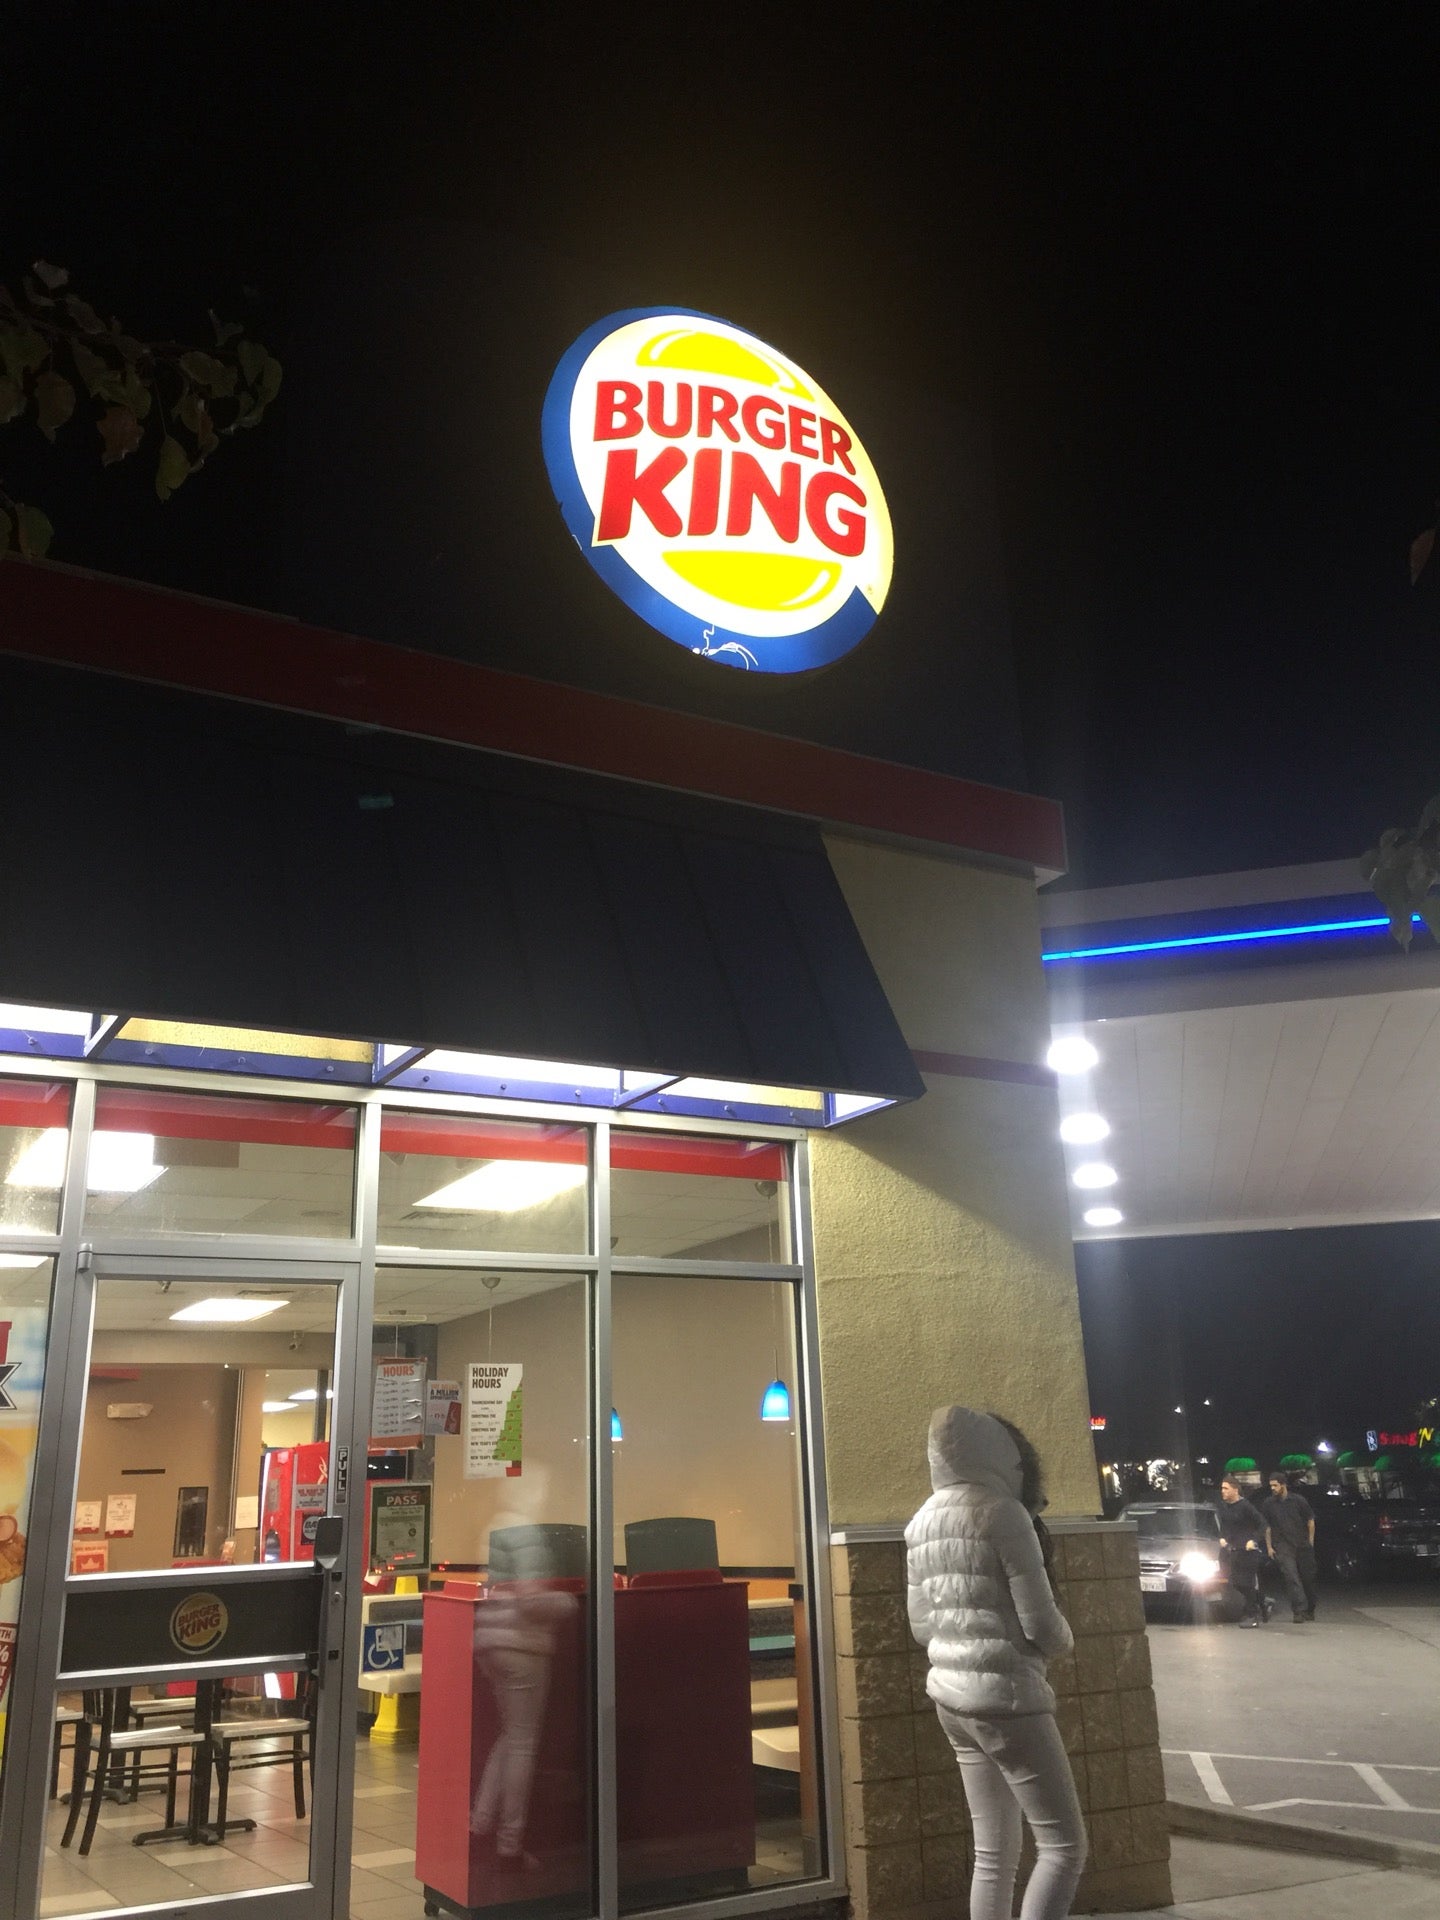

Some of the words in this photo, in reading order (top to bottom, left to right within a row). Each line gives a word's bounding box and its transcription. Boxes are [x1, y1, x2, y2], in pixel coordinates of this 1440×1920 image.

[593, 380, 856, 475] BURGER
[597, 446, 867, 557] KING
[383, 1366, 414, 1377] HOURS
[472, 1367, 509, 1378] HOLIDAY
[472, 1379, 501, 1389] HOURS
[338, 1451, 348, 1491] PULL
[386, 1495, 418, 1506] PASS
[178, 1604, 220, 1627] BURGER
[180, 1613, 220, 1639] KING
